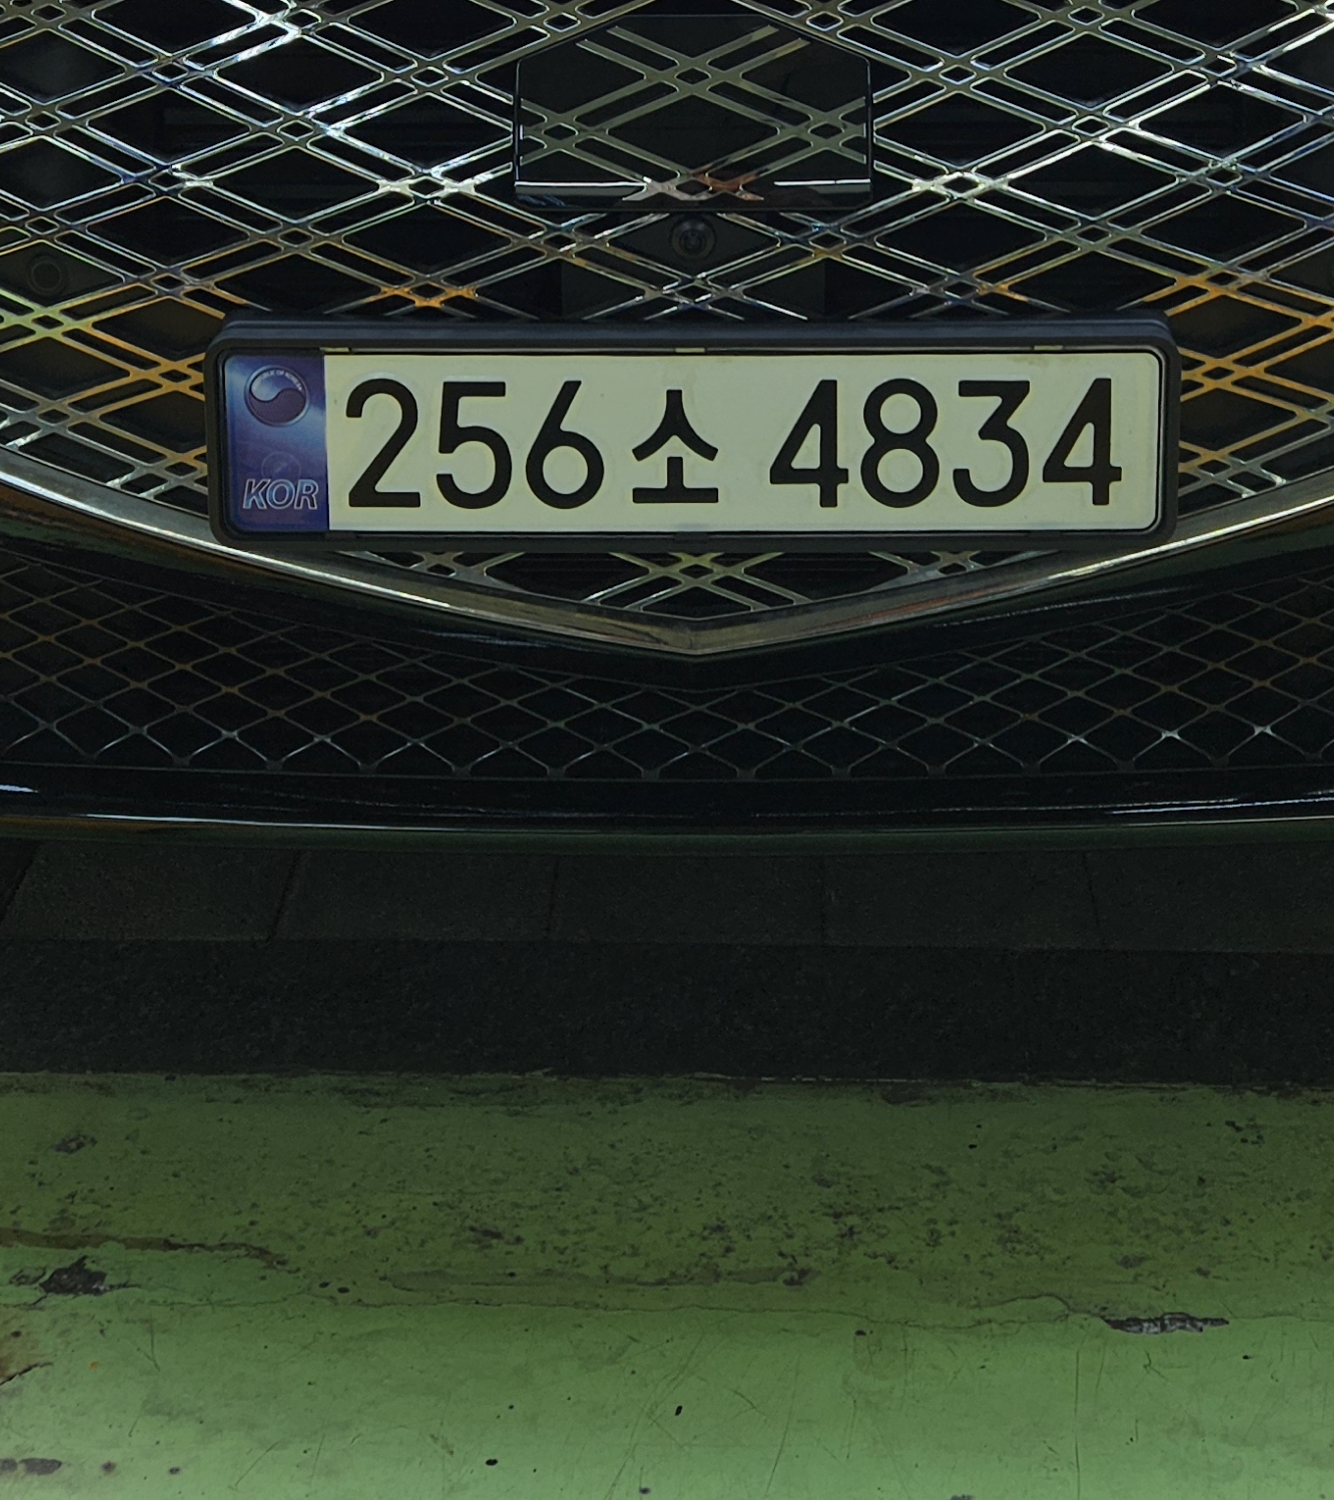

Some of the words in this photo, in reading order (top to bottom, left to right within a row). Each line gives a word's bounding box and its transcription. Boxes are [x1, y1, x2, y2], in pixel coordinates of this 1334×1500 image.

[345, 377, 720, 510] 256소
[769, 377, 1122, 510] 4834
[243, 478, 319, 510] KOR
